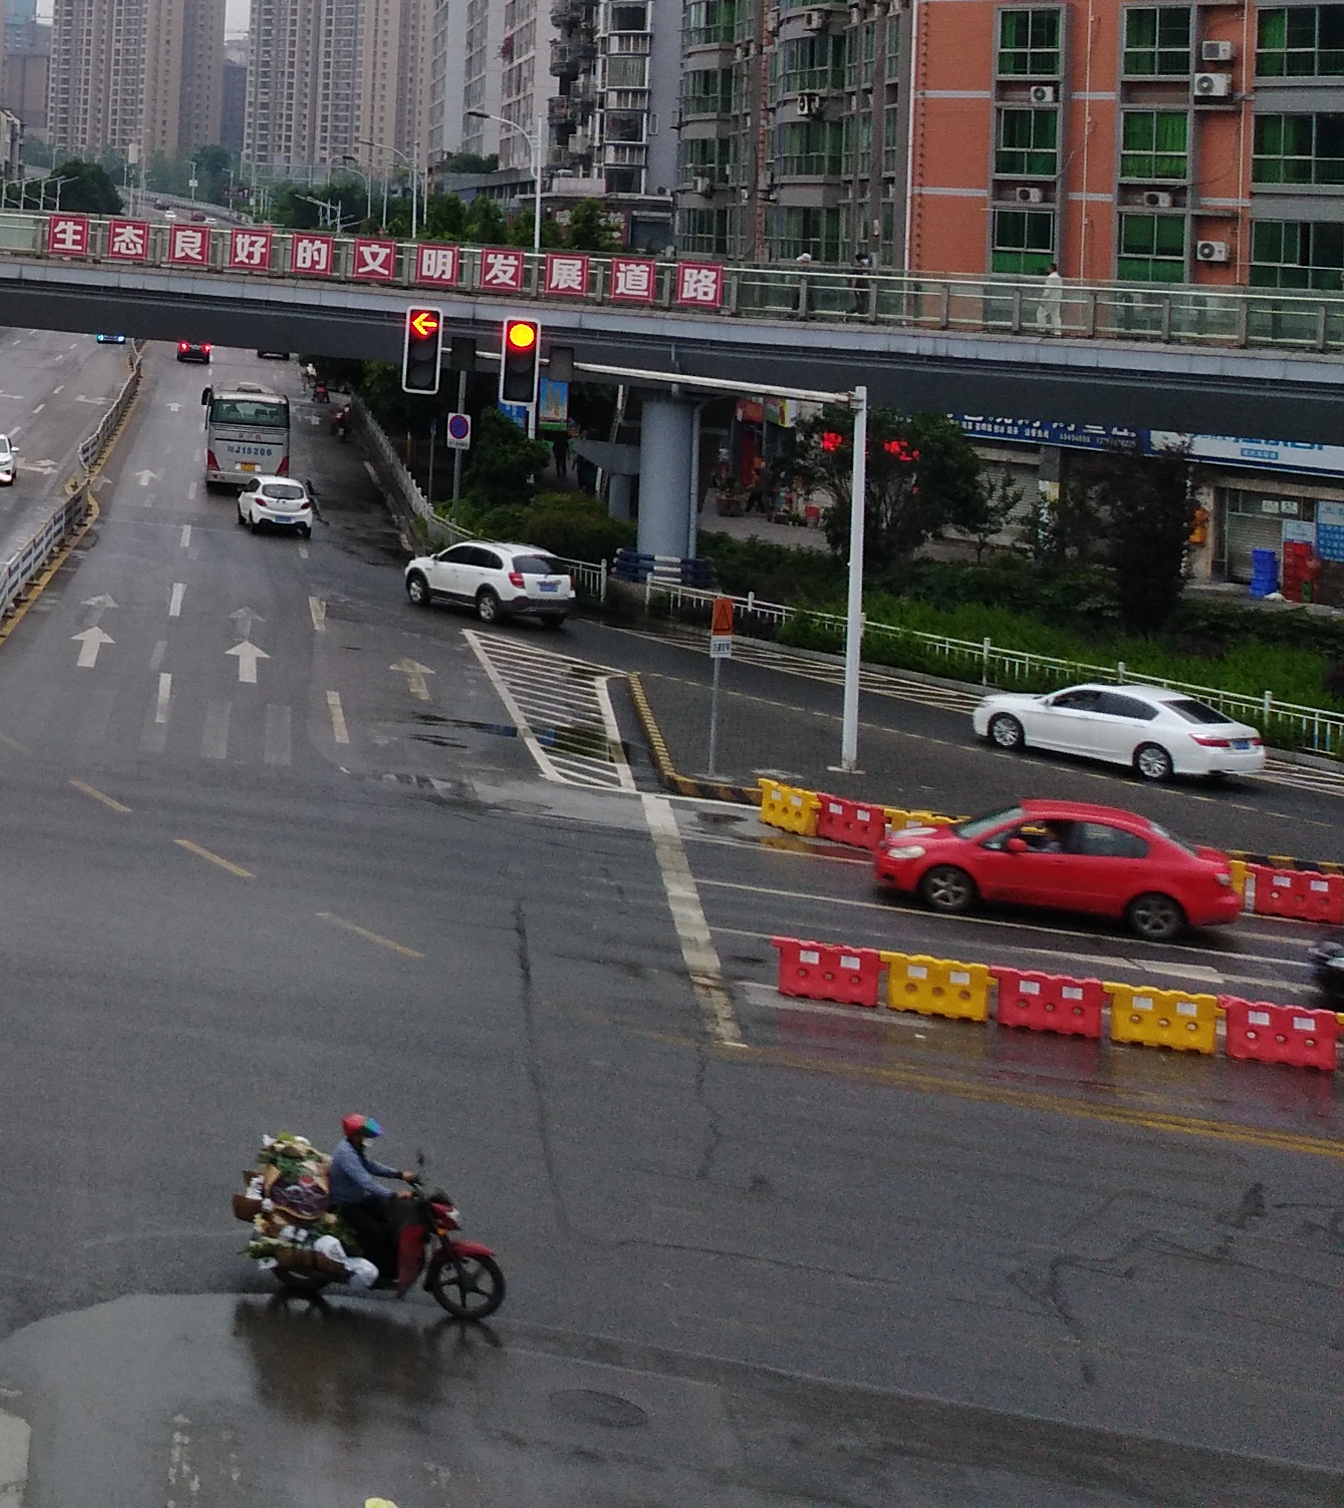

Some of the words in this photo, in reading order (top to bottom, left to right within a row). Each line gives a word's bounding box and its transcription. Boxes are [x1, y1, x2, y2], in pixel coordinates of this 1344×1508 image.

[54, 221, 717, 301] 生态良好的文明发展道路
